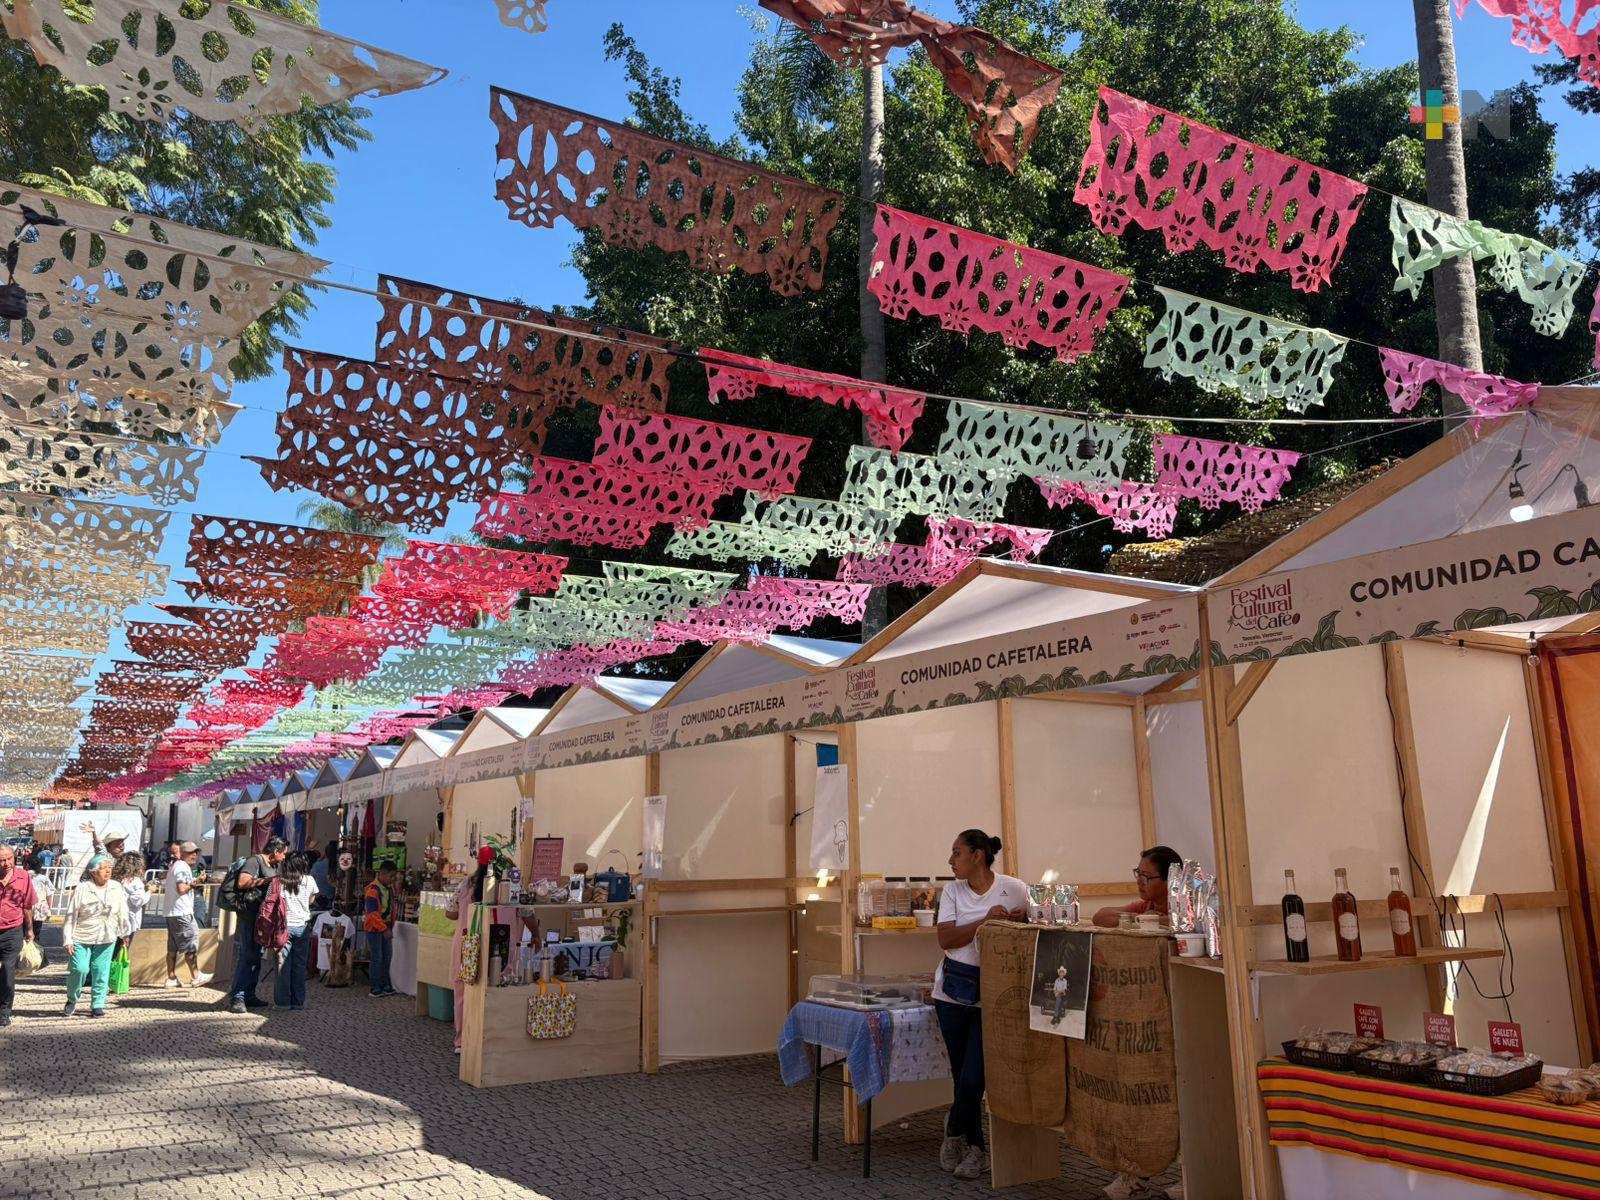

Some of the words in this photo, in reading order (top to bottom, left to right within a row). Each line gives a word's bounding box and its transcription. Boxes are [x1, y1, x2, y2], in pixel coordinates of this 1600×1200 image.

[1350, 549, 1541, 603] COMUNIDAD
[1230, 578, 1292, 606] Festival
[1232, 596, 1293, 620] Cultural
[1257, 611, 1292, 630] Café
[901, 657, 982, 685] COMUNIDAD
[987, 635, 1093, 669] CAFETALERA
[847, 666, 876, 682] Festival
[681, 709, 726, 726] COMUNIDAD
[728, 696, 785, 717] CAFETALERA
[549, 737, 579, 752] COMUNIDAD
[579, 730, 616, 746] CAFETALERA
[1092, 965, 1156, 1001] onasupo
[1113, 1019, 1162, 1055] FRIJOL
[1492, 1027, 1518, 1038] GALLETA
[1493, 1036, 1501, 1045] DE
[1502, 1037, 1519, 1048] NUEZ
